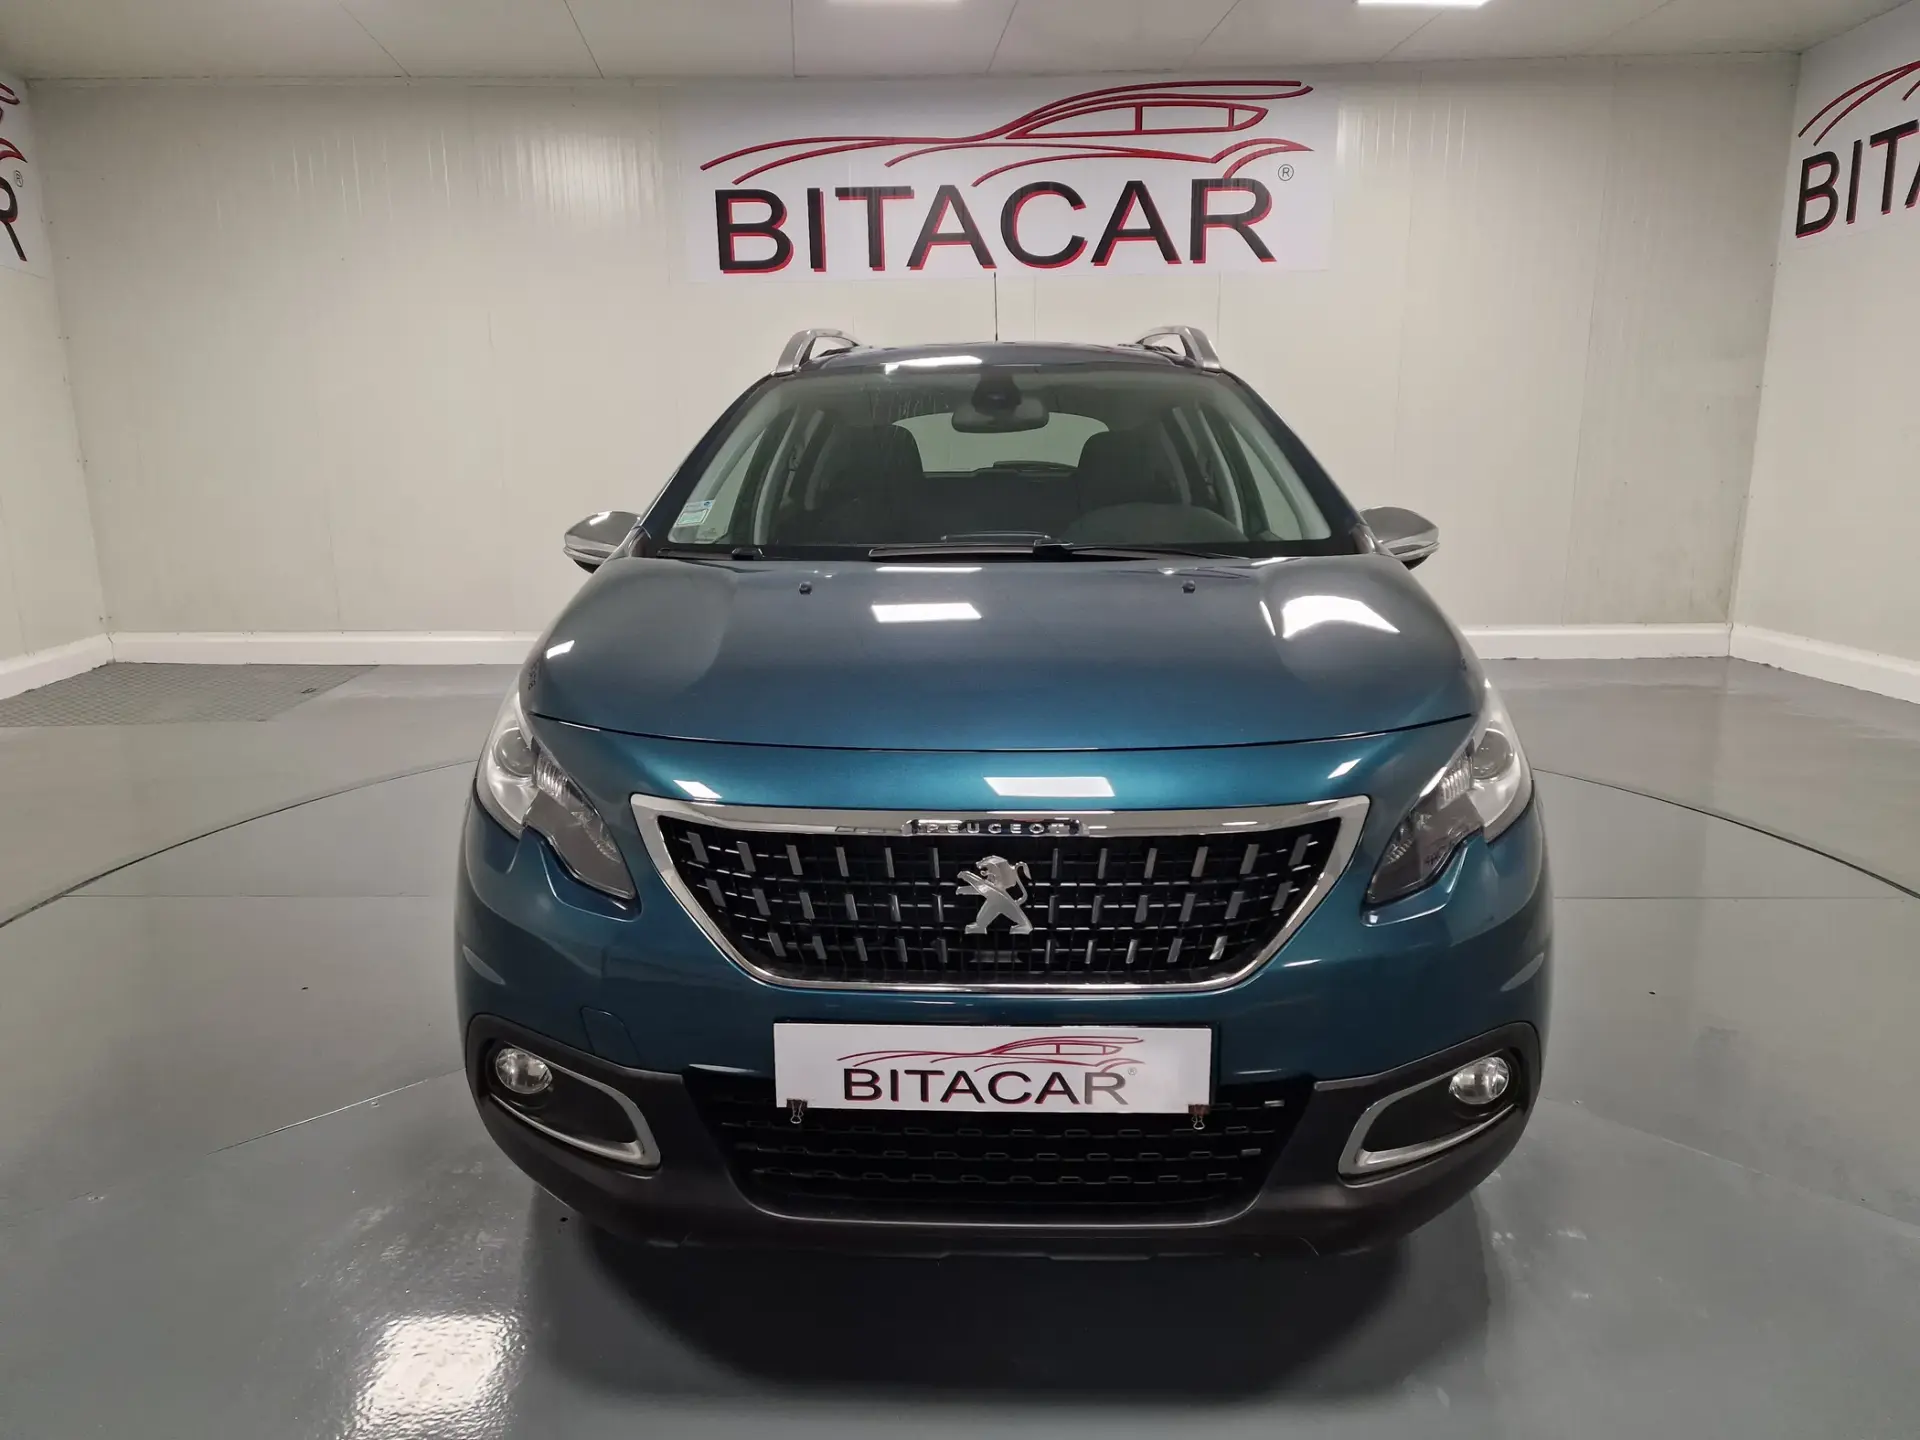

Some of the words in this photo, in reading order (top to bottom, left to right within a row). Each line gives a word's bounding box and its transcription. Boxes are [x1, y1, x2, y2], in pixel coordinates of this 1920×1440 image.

[715, 177, 1277, 274] BITACAR
[926, 822, 1067, 835] PEUGEOT
[843, 1067, 1130, 1106] BITACAR
